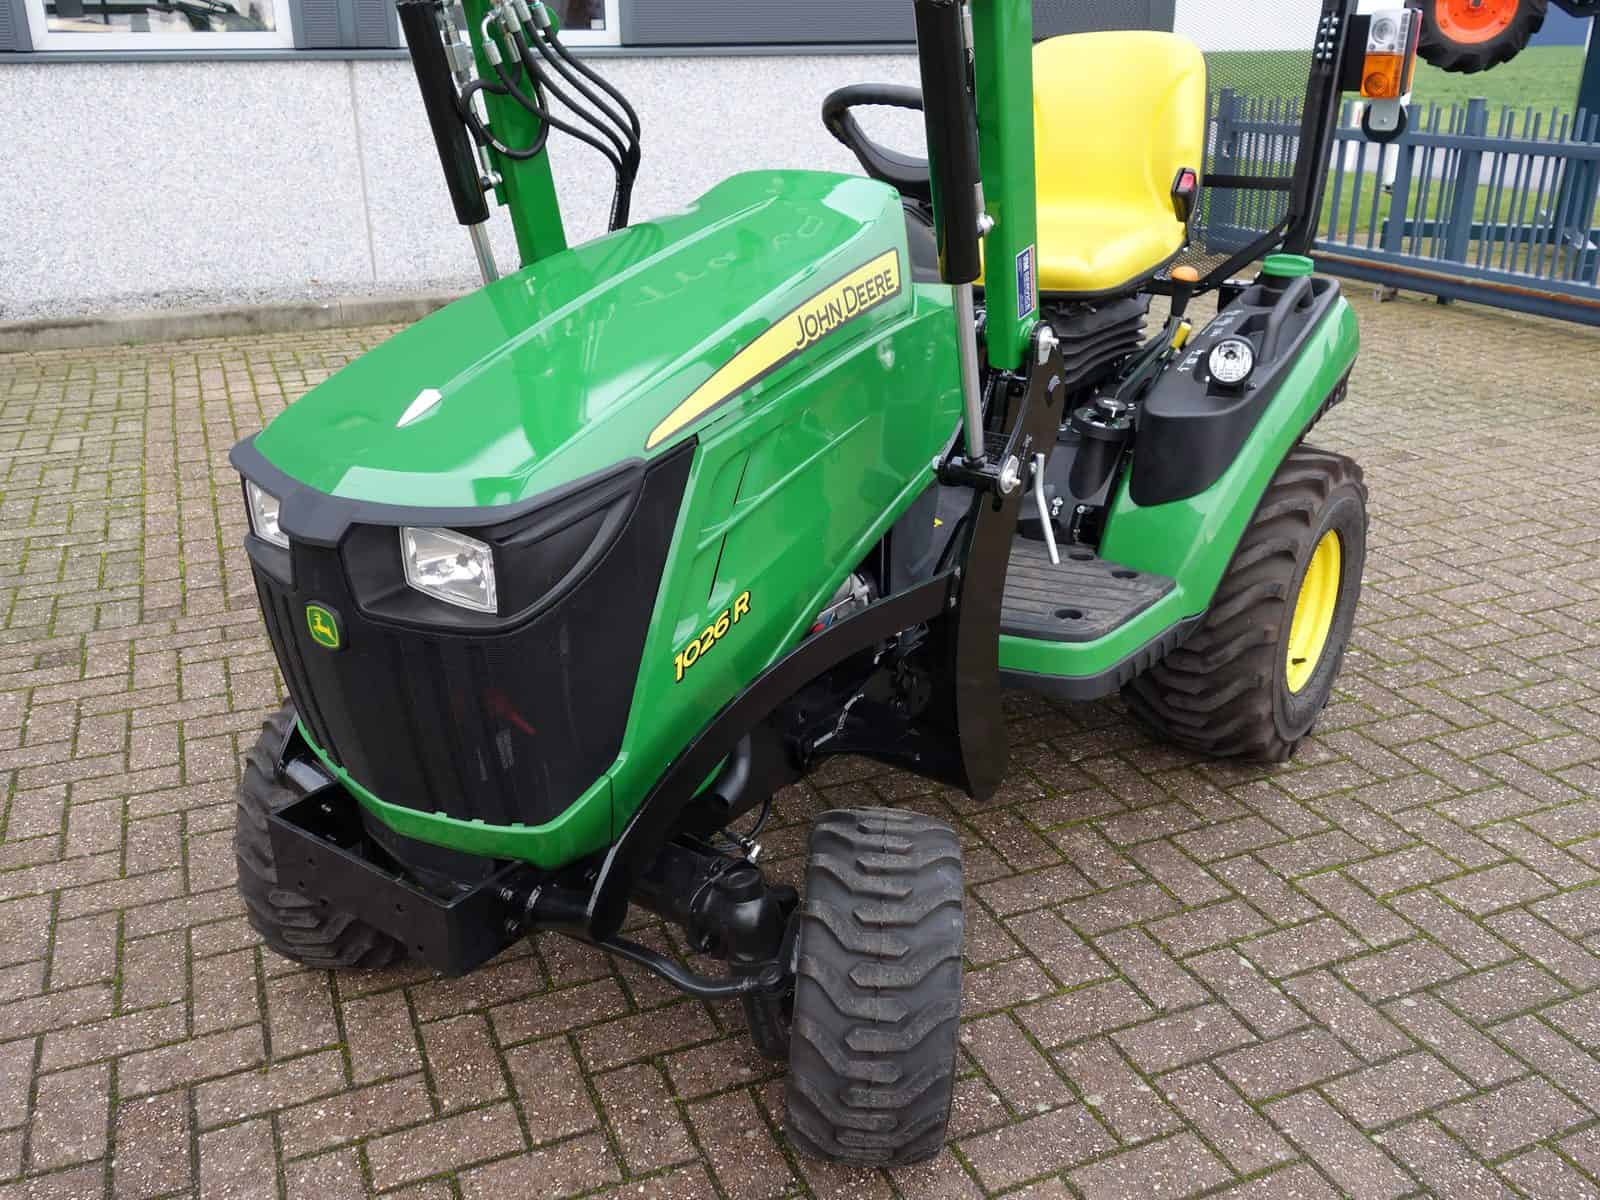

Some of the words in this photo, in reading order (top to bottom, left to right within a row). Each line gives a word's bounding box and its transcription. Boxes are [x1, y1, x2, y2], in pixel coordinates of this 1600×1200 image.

[796, 297, 843, 346] JOHN
[842, 269, 895, 314] DEERE
[674, 608, 731, 683] 1026
[733, 591, 751, 624] R
